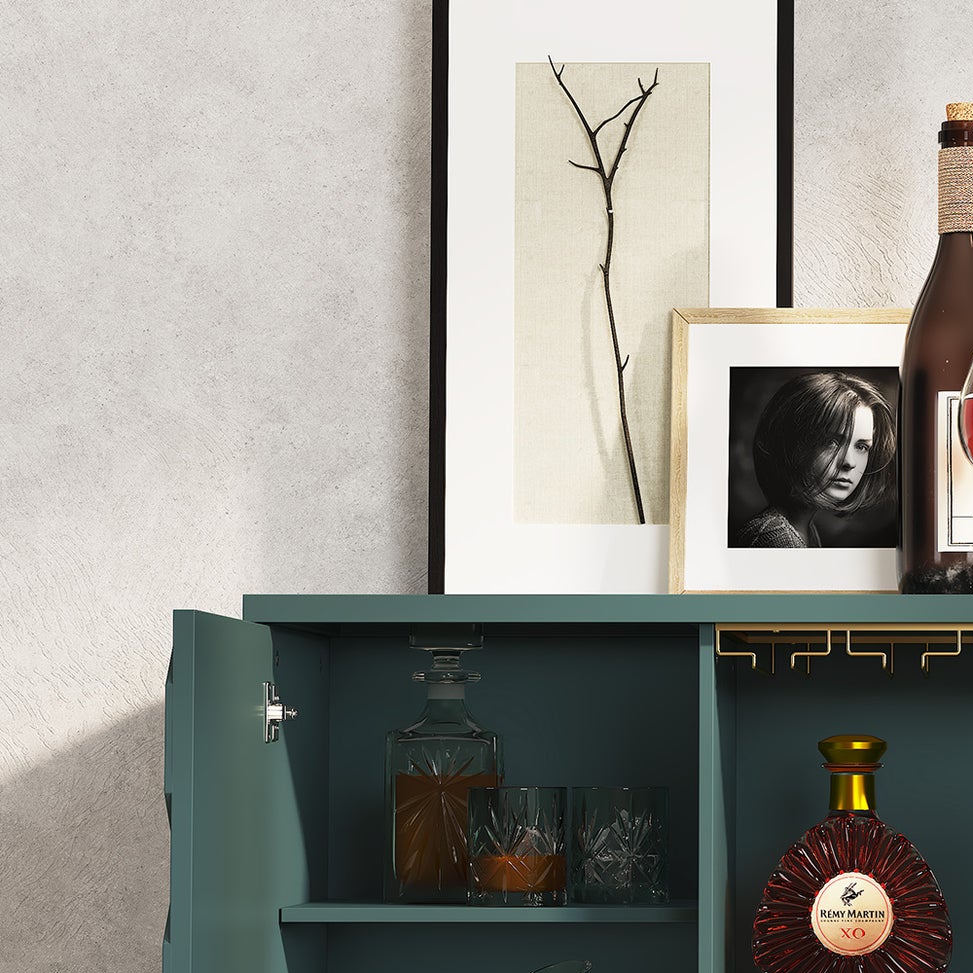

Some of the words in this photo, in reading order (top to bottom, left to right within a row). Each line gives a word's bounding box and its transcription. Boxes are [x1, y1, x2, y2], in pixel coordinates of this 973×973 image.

[820, 909, 846, 918] RÉMY
[847, 909, 885, 918] MARTIN
[840, 927, 866, 939] XO
